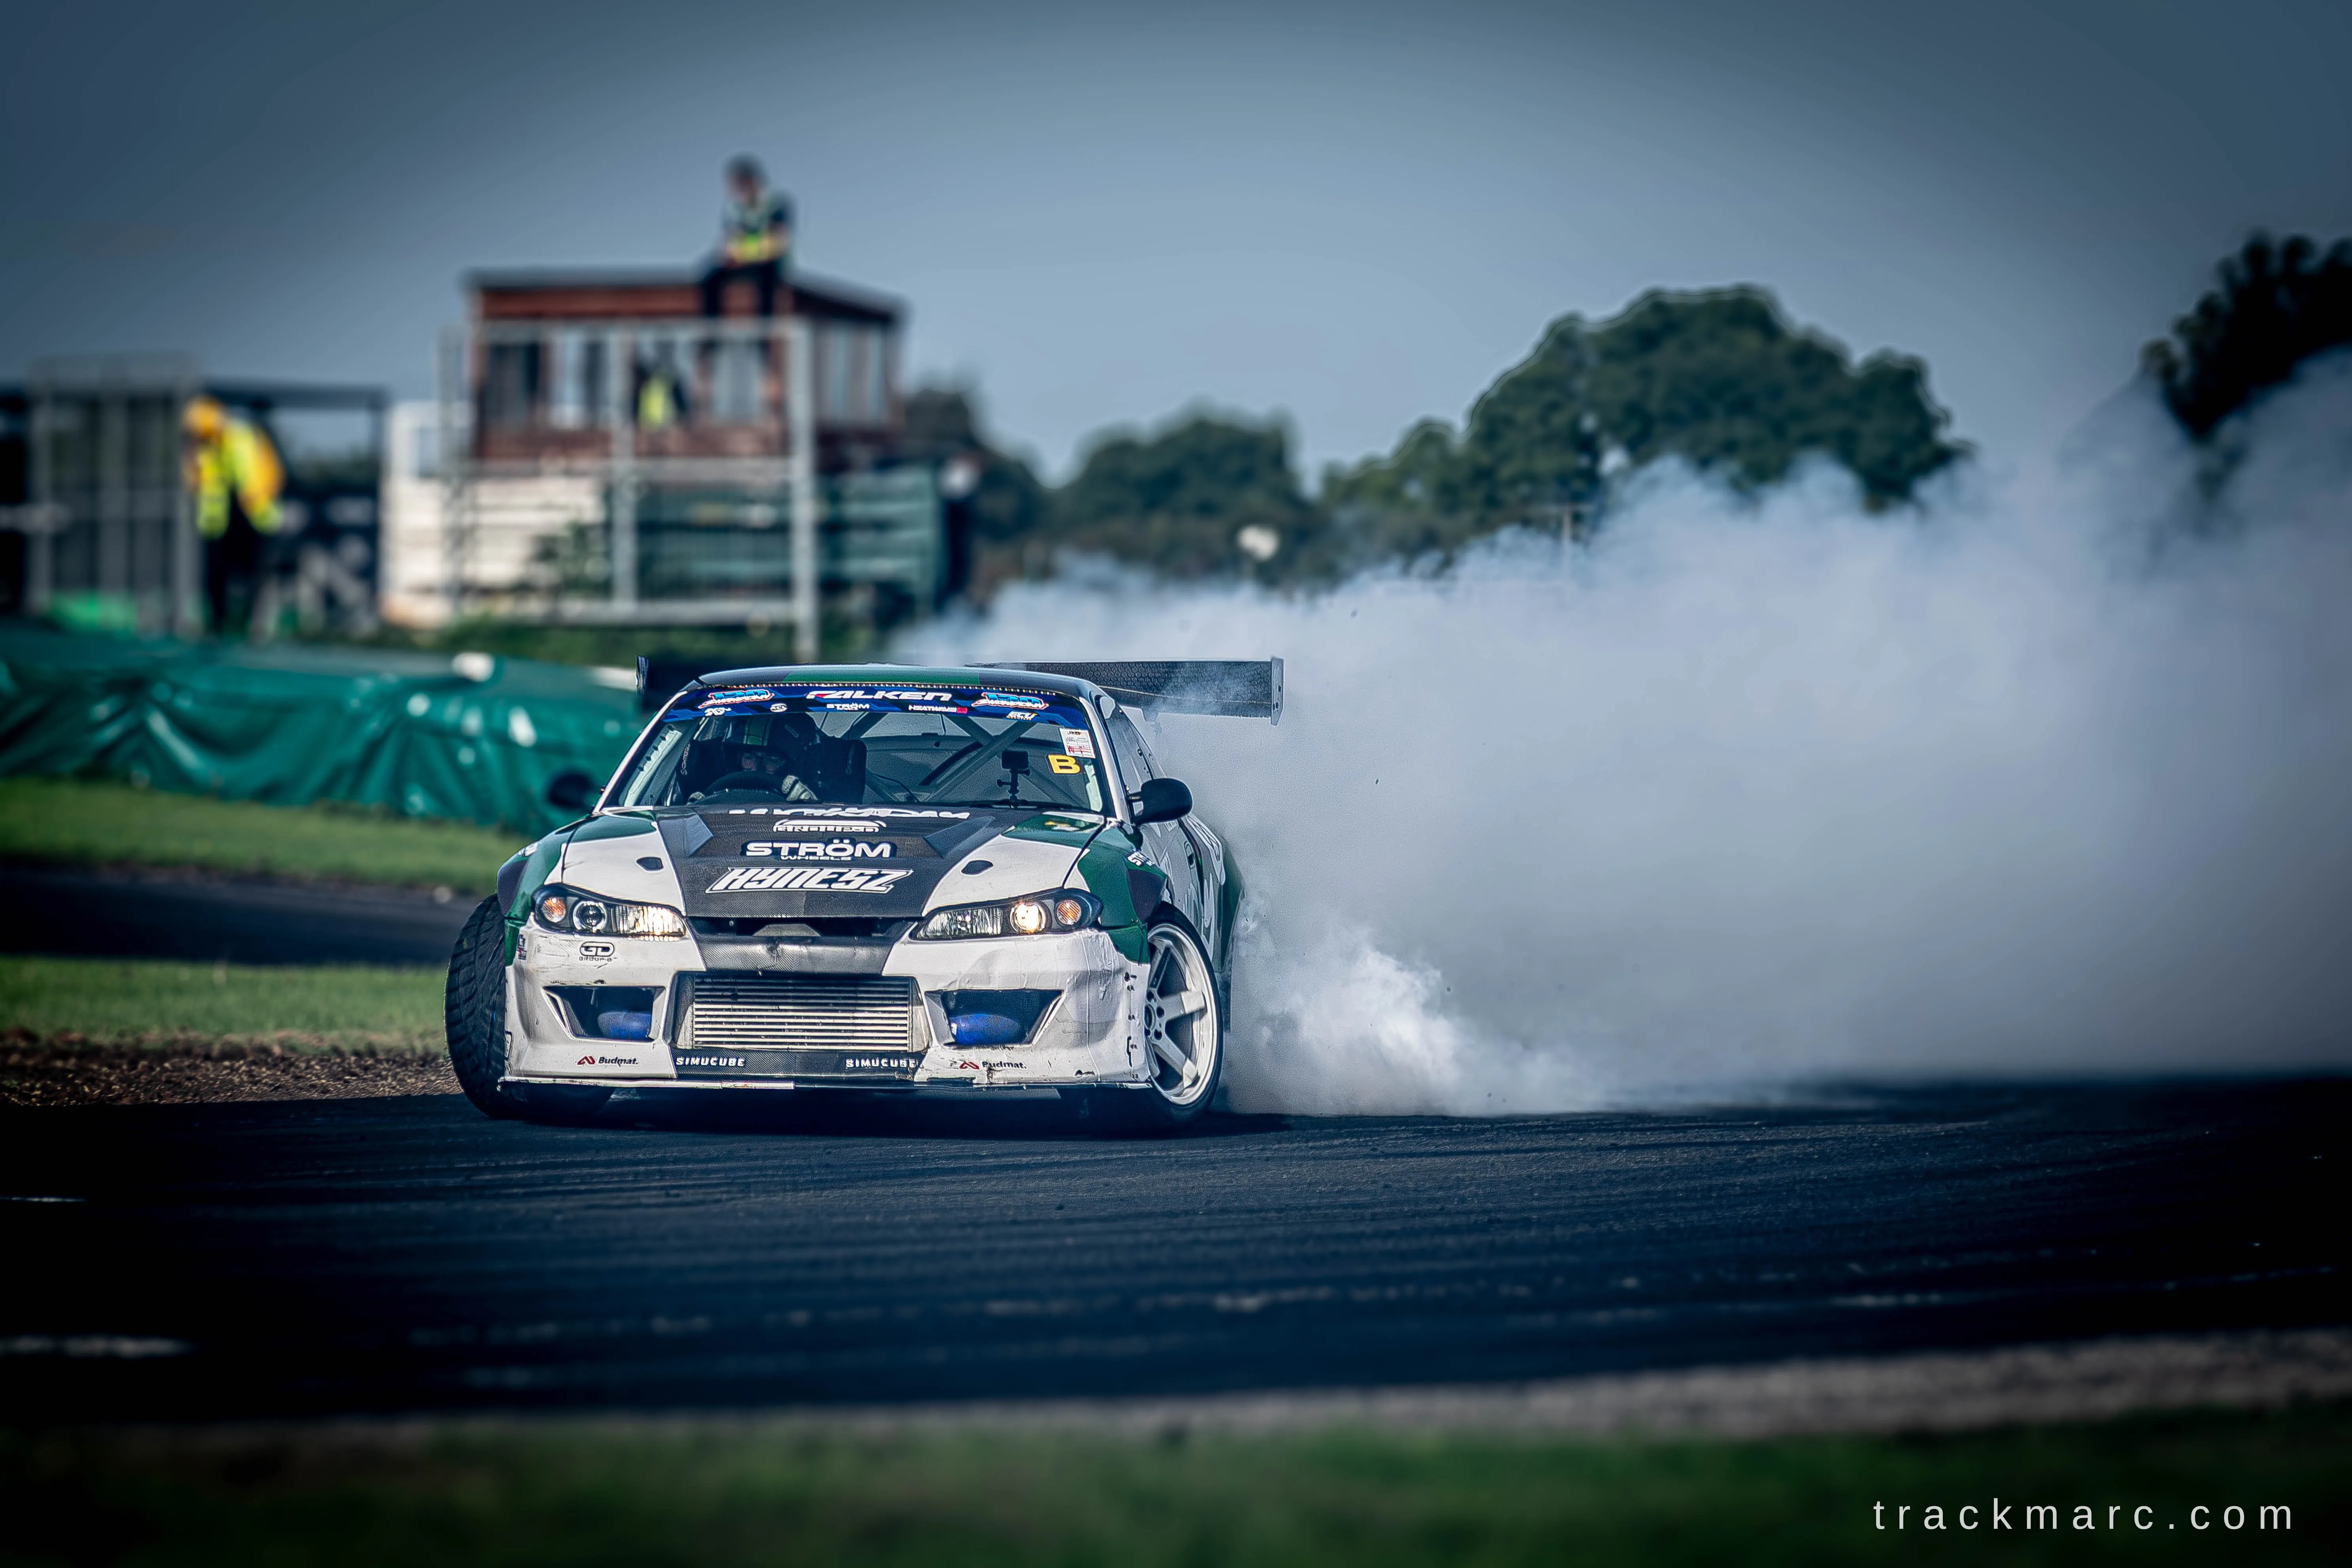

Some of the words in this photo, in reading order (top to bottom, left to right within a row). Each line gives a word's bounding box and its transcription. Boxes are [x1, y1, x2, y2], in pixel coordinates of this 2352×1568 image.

[806, 690, 952, 701] FALKEN
[1048, 754, 1080, 774] B
[746, 839, 891, 858] STRÖM
[676, 1057, 745, 1067] SIMUCUBE
[846, 1058, 916, 1068] SIMUCUBE
